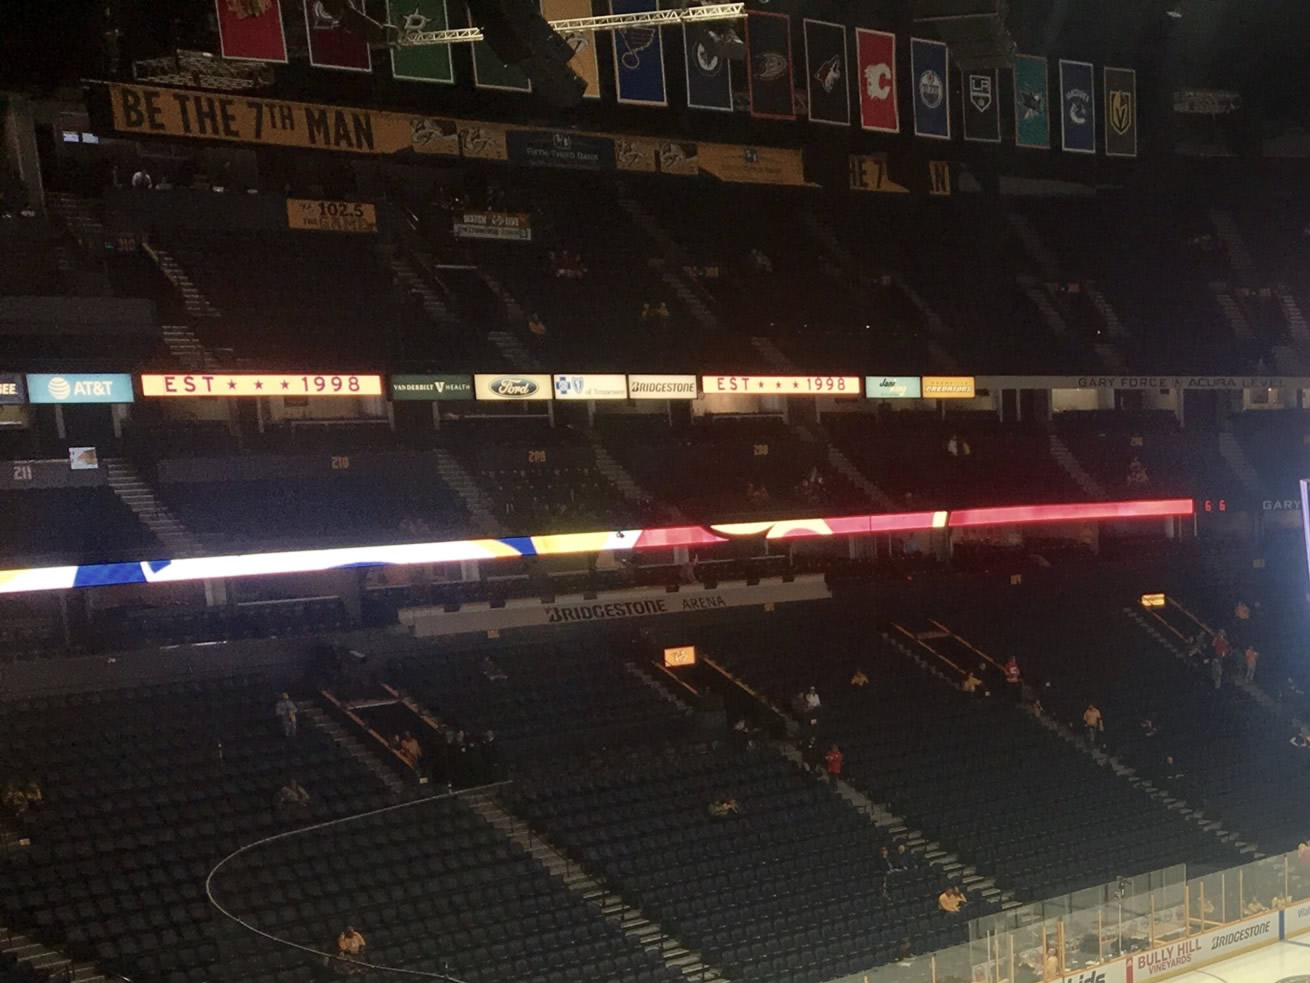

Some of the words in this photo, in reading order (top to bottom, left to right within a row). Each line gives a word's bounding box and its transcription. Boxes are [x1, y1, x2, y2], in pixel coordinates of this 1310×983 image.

[121, 89, 166, 130] BE
[173, 92, 241, 138] THE
[248, 101, 296, 139] 7TH
[305, 107, 374, 151] MAN
[318, 202, 364, 218] 102.5
[74, 380, 112, 396] AT&T
[165, 376, 214, 392] EST
[301, 376, 361, 392] 1998
[498, 380, 530, 394] Ford
[631, 381, 696, 392] BRIDGESTONE
[717, 377, 750, 391] EST
[807, 378, 847, 391] 1998
[1078, 378, 1114, 388] GARY
[1120, 378, 1168, 388] FORCE
[1188, 378, 1236, 388] ACURA
[1262, 500, 1301, 511] GARY
[545, 599, 668, 623] BRIDGESTONE
[683, 596, 727, 610] ARENA
[1211, 921, 1271, 951] BRIDGESTONE
[1138, 948, 1175, 971] BULLY
[1176, 937, 1203, 957] HILL
[1149, 953, 1193, 976] VINEYARDS
